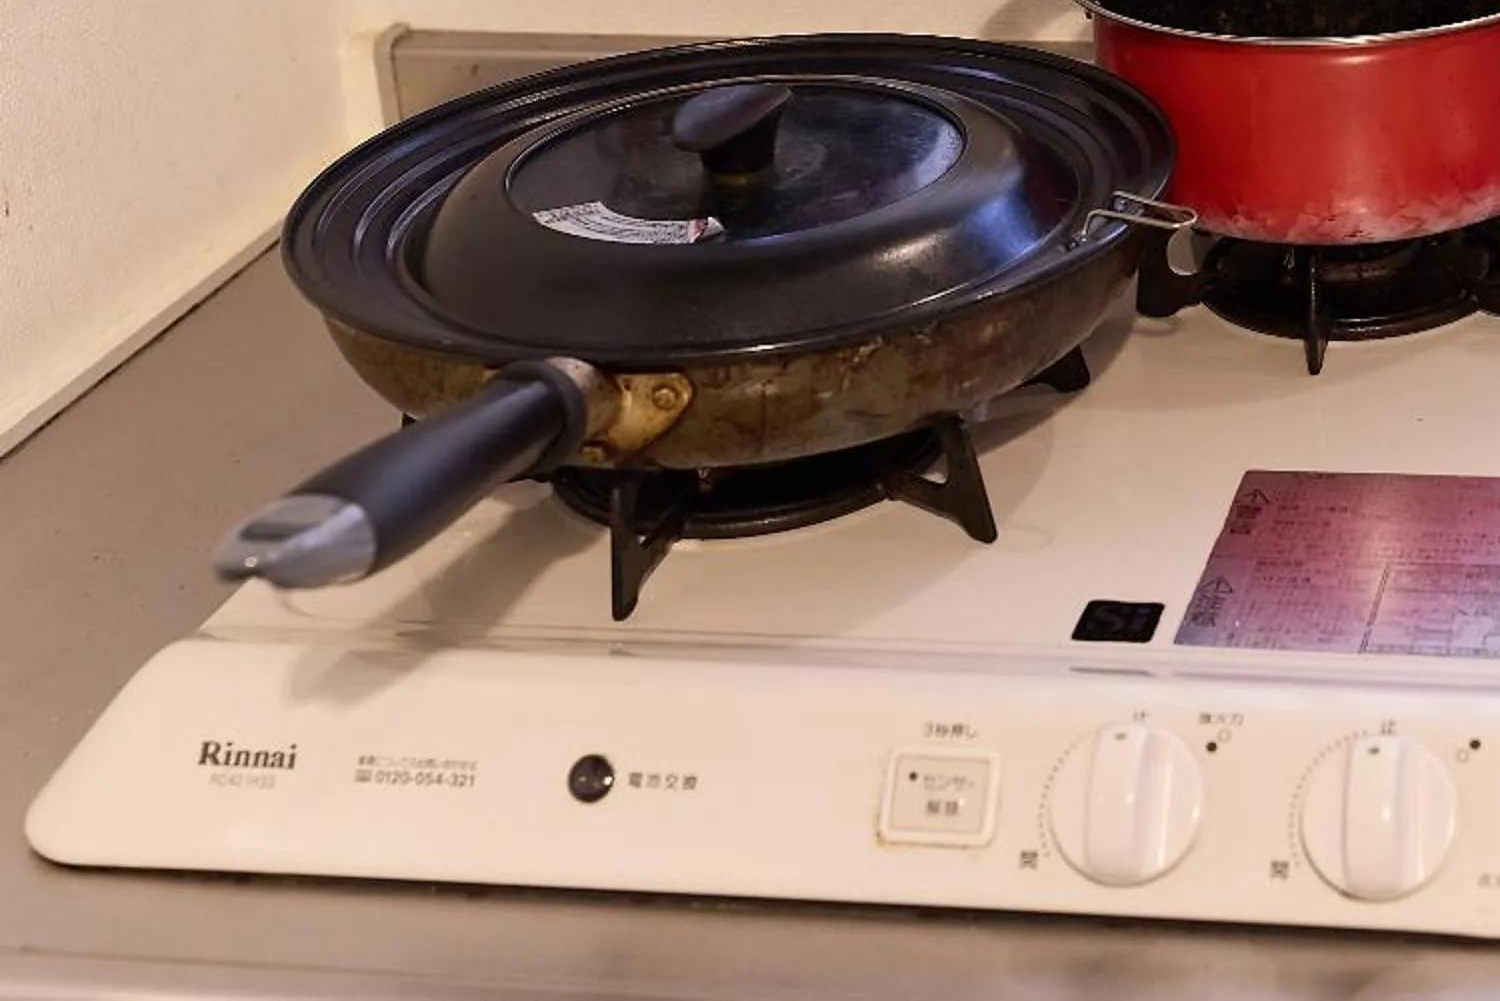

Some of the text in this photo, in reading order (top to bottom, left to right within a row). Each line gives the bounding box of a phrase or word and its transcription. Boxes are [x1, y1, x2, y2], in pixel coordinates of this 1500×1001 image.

[198, 741, 298, 770] Rinnai
[628, 772, 698, 790] 電池交換
